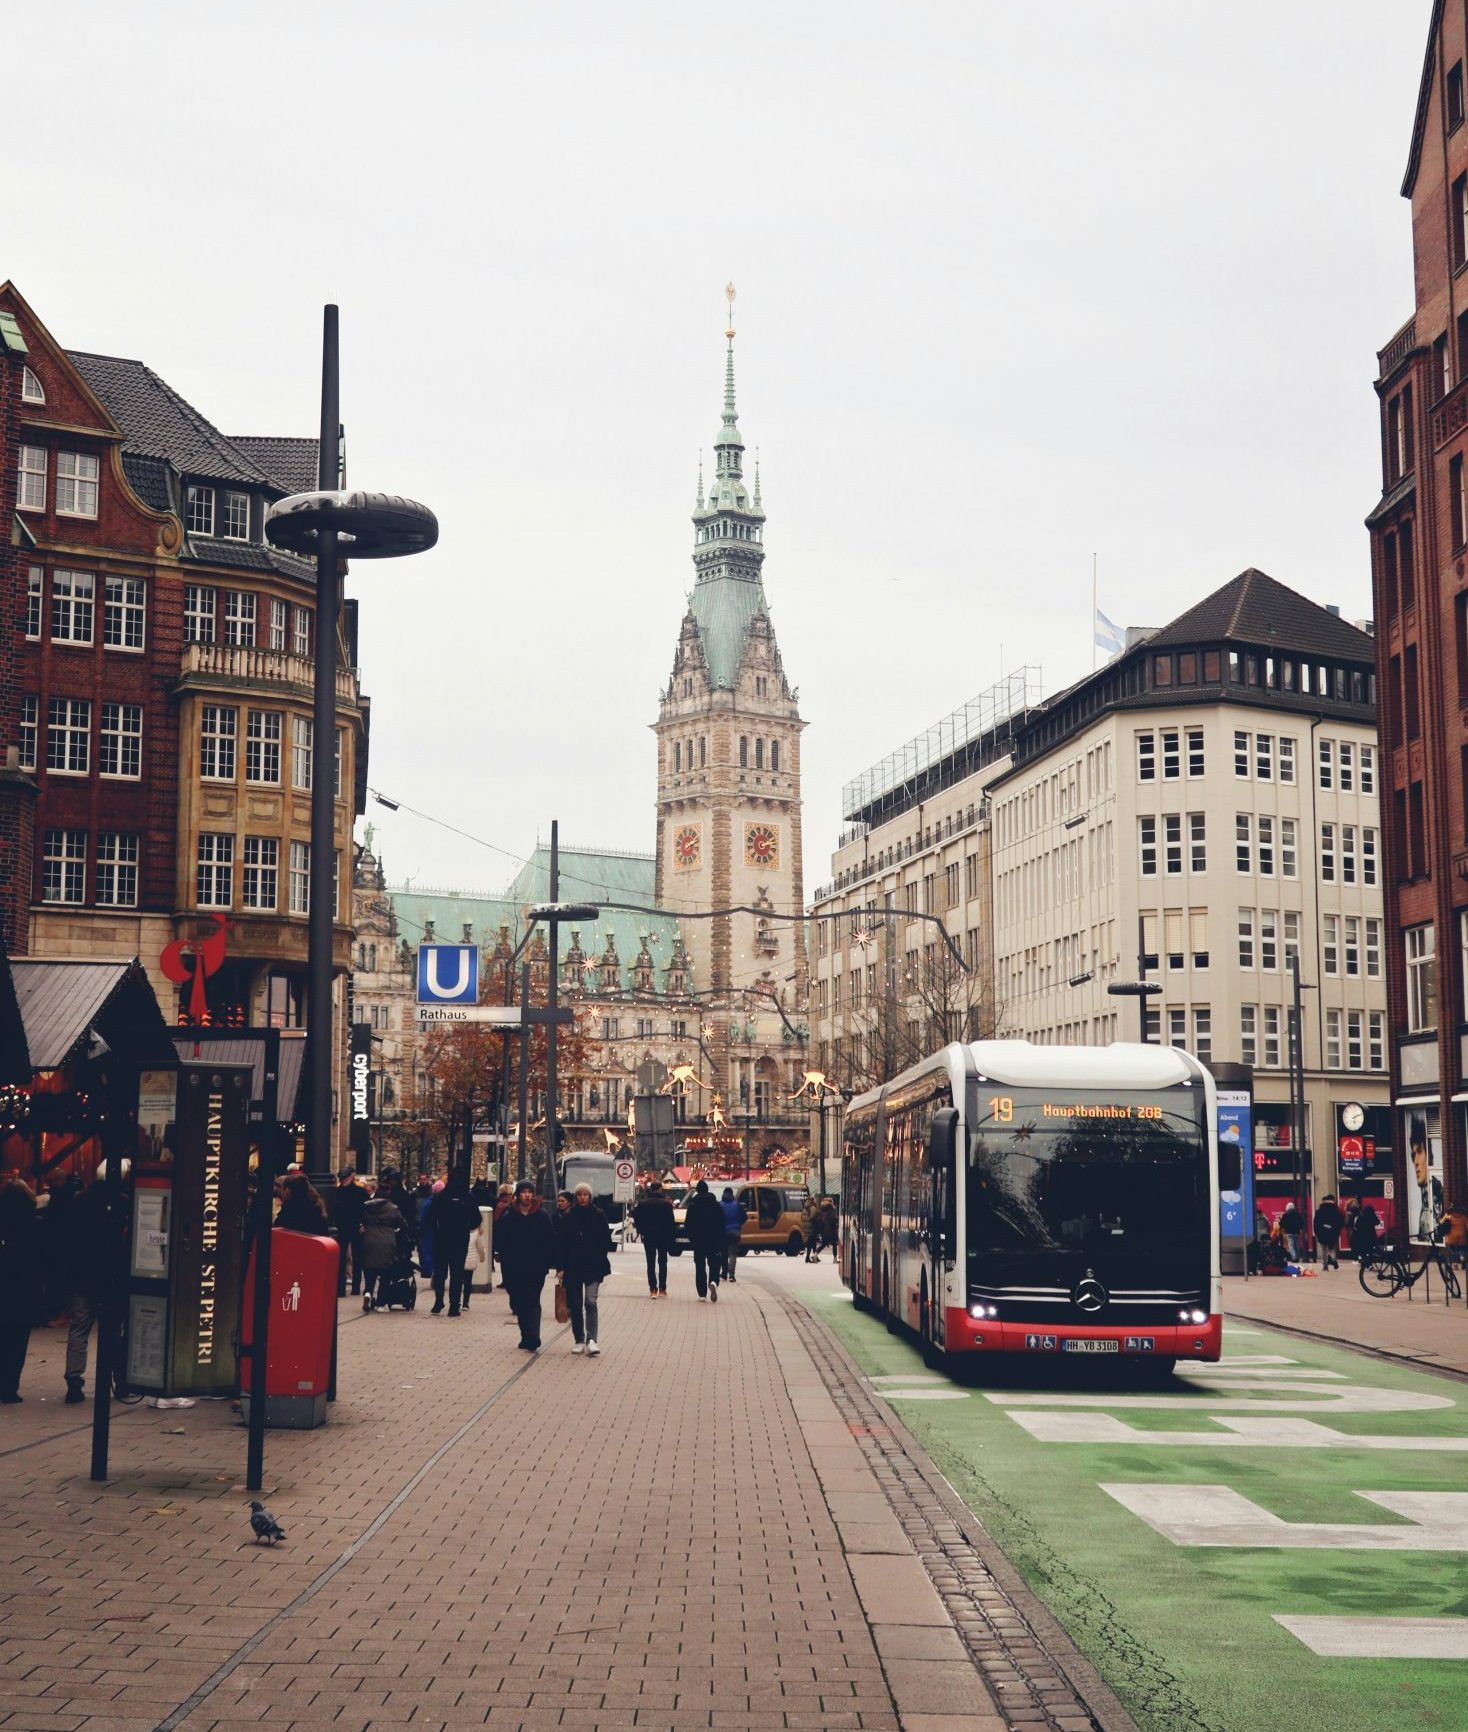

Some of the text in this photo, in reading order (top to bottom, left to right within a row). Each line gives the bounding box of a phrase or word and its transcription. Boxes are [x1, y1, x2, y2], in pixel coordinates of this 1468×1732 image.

[427, 948, 470, 998] U
[420, 1009, 467, 1020] Rathaus
[352, 1053, 370, 1120] cyberport
[988, 1097, 1162, 1121] 19 Hauptbahnhof ZOB
[1220, 1113, 1239, 1121] Abend
[1254, 1152, 1265, 1170] T
[202, 1094, 222, 1252] HAUPTKIRCHE
[1067, 1341, 1117, 1351] HH YB 3108
